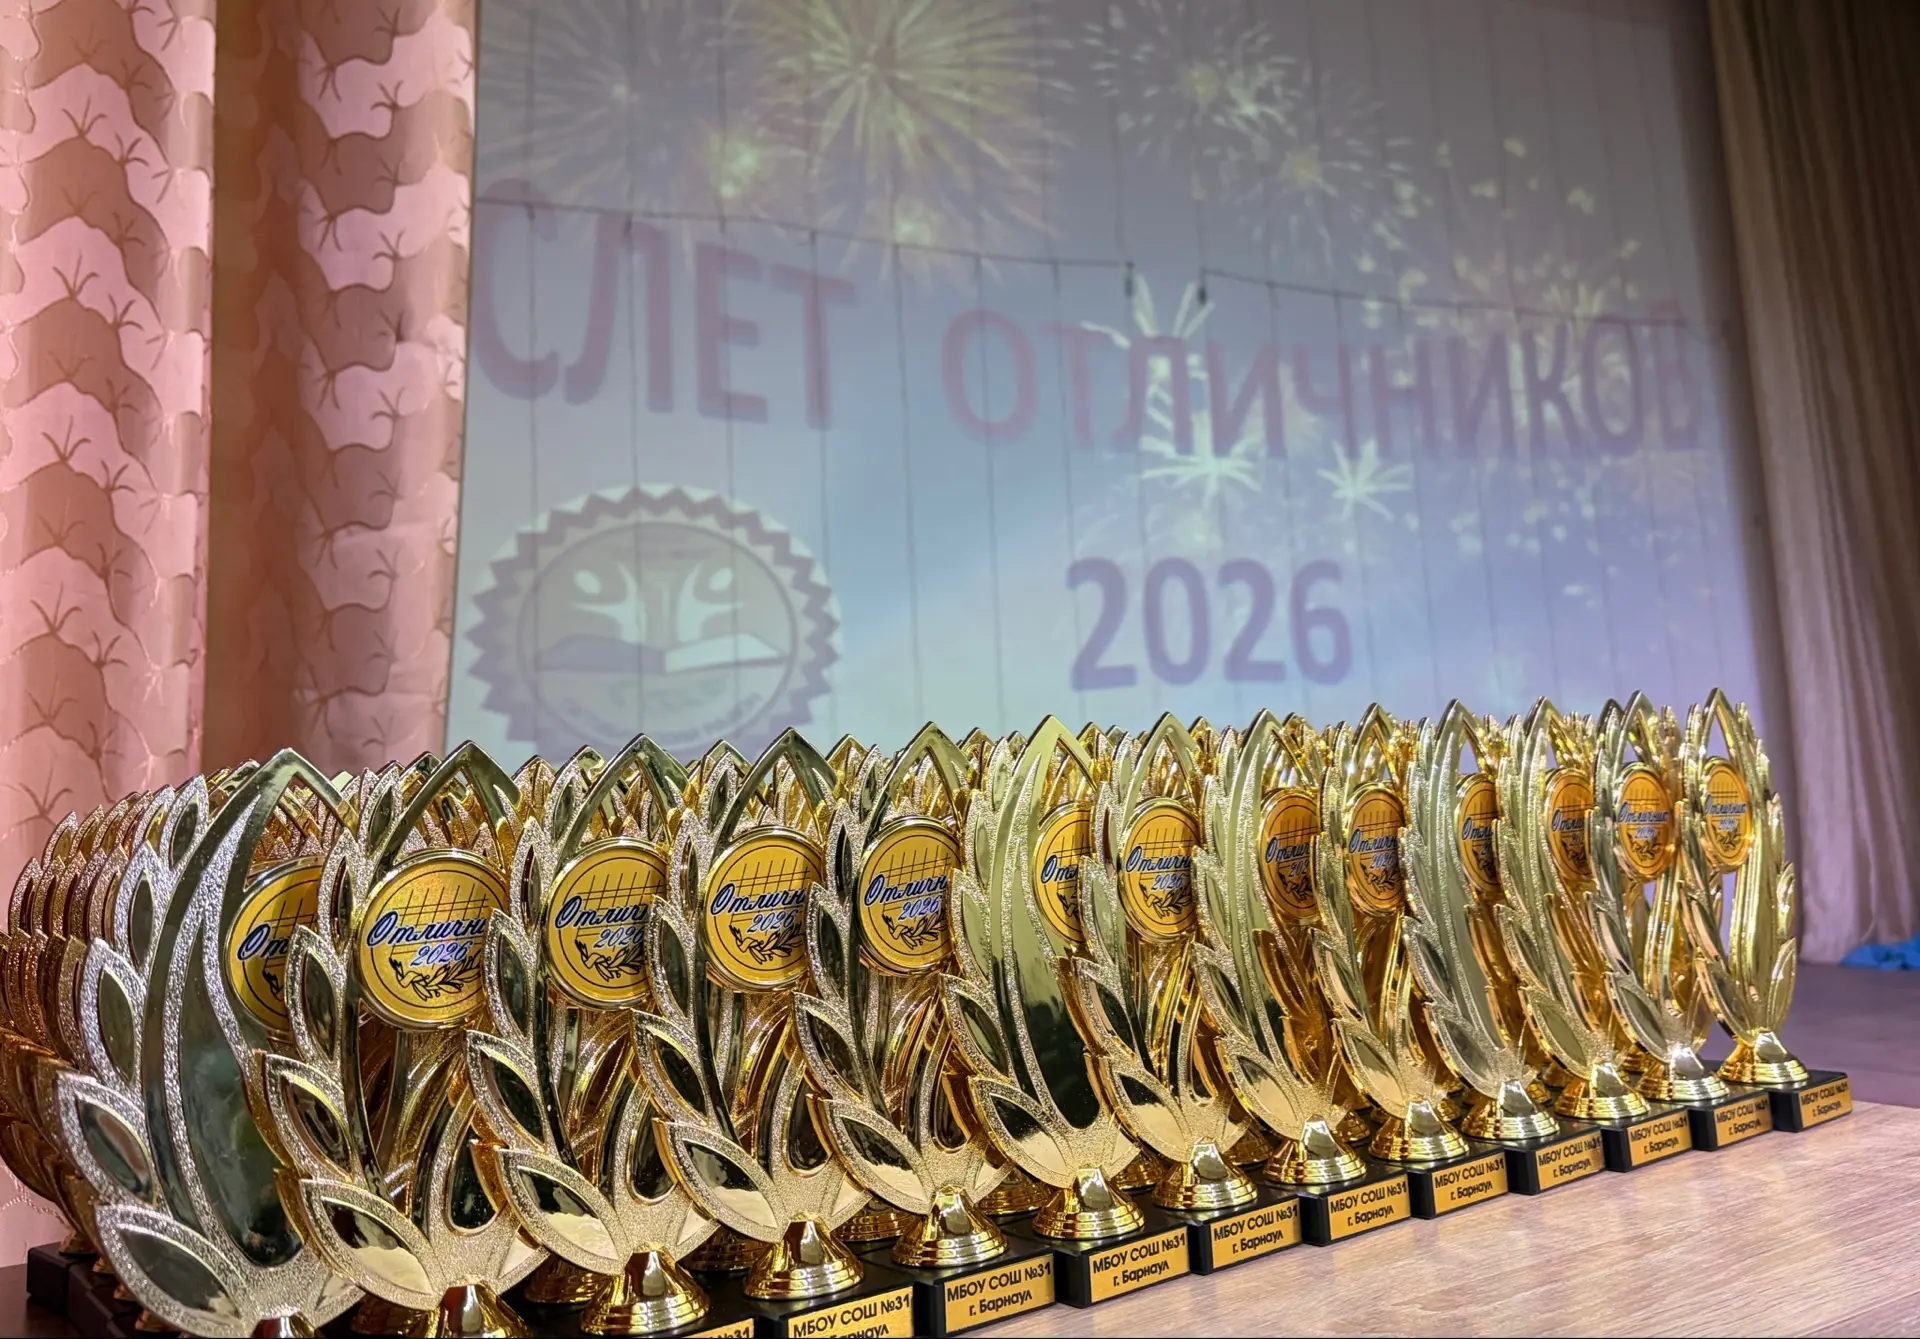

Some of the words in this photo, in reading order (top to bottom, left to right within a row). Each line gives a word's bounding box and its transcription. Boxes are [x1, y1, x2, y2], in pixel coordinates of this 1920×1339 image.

[473, 177, 861, 432] СЛЕТ
[939, 299, 1706, 460] ОТЛИЧНИКОВ
[1064, 555, 1354, 693] 2026
[1349, 828, 1398, 853] Отличн
[1126, 845, 1191, 872] Отличн
[1289, 860, 1309, 877] 202
[864, 874, 948, 906] Отличн
[1151, 873, 1185, 890] 2026
[555, 895, 648, 929] Отлич
[710, 883, 805, 915] Отличн
[898, 894, 942, 920] 2026
[366, 910, 487, 947] Отличн
[747, 909, 799, 933] 2026
[593, 926, 644, 948] 2026
[409, 940, 473, 967] 2026
[1434, 1170, 1461, 1188] МБОУ
[1462, 1163, 1485, 1180] СОШ
[1486, 1157, 1504, 1173] №31
[1330, 1193, 1359, 1214] МБОУ
[1360, 1187, 1386, 1204] СОШ
[1386, 1181, 1407, 1198] №31
[1457, 1180, 1493, 1198] Барнаул
[1213, 1220, 1246, 1241] МБОУ
[1247, 1211, 1274, 1230] СОШ
[1276, 1204, 1298, 1222] №31
[1347, 1216, 1353, 1227] г.
[1354, 1205, 1394, 1224] Барнаул
[1093, 1250, 1128, 1274] МБОУ
[1130, 1241, 1160, 1262] СОШ
[1162, 1233, 1185, 1252] №31
[1232, 1243, 1239, 1254] г.
[1240, 1230, 1284, 1252] Барнаул
[947, 1278, 986, 1302] МБОУ
[989, 1269, 1022, 1290] СОШ
[1024, 1261, 1051, 1281] №31
[1113, 1275, 1120, 1287] г.
[1122, 1260, 1169, 1284] Барнаул
[793, 1313, 837, 1338] МБОУ
[840, 1302, 878, 1325] СОШ
[881, 1293, 910, 1314] №31
[969, 1304, 976, 1316] г.
[979, 1290, 1033, 1313] Барнаул
[830, 1324, 889, 1338] наул
